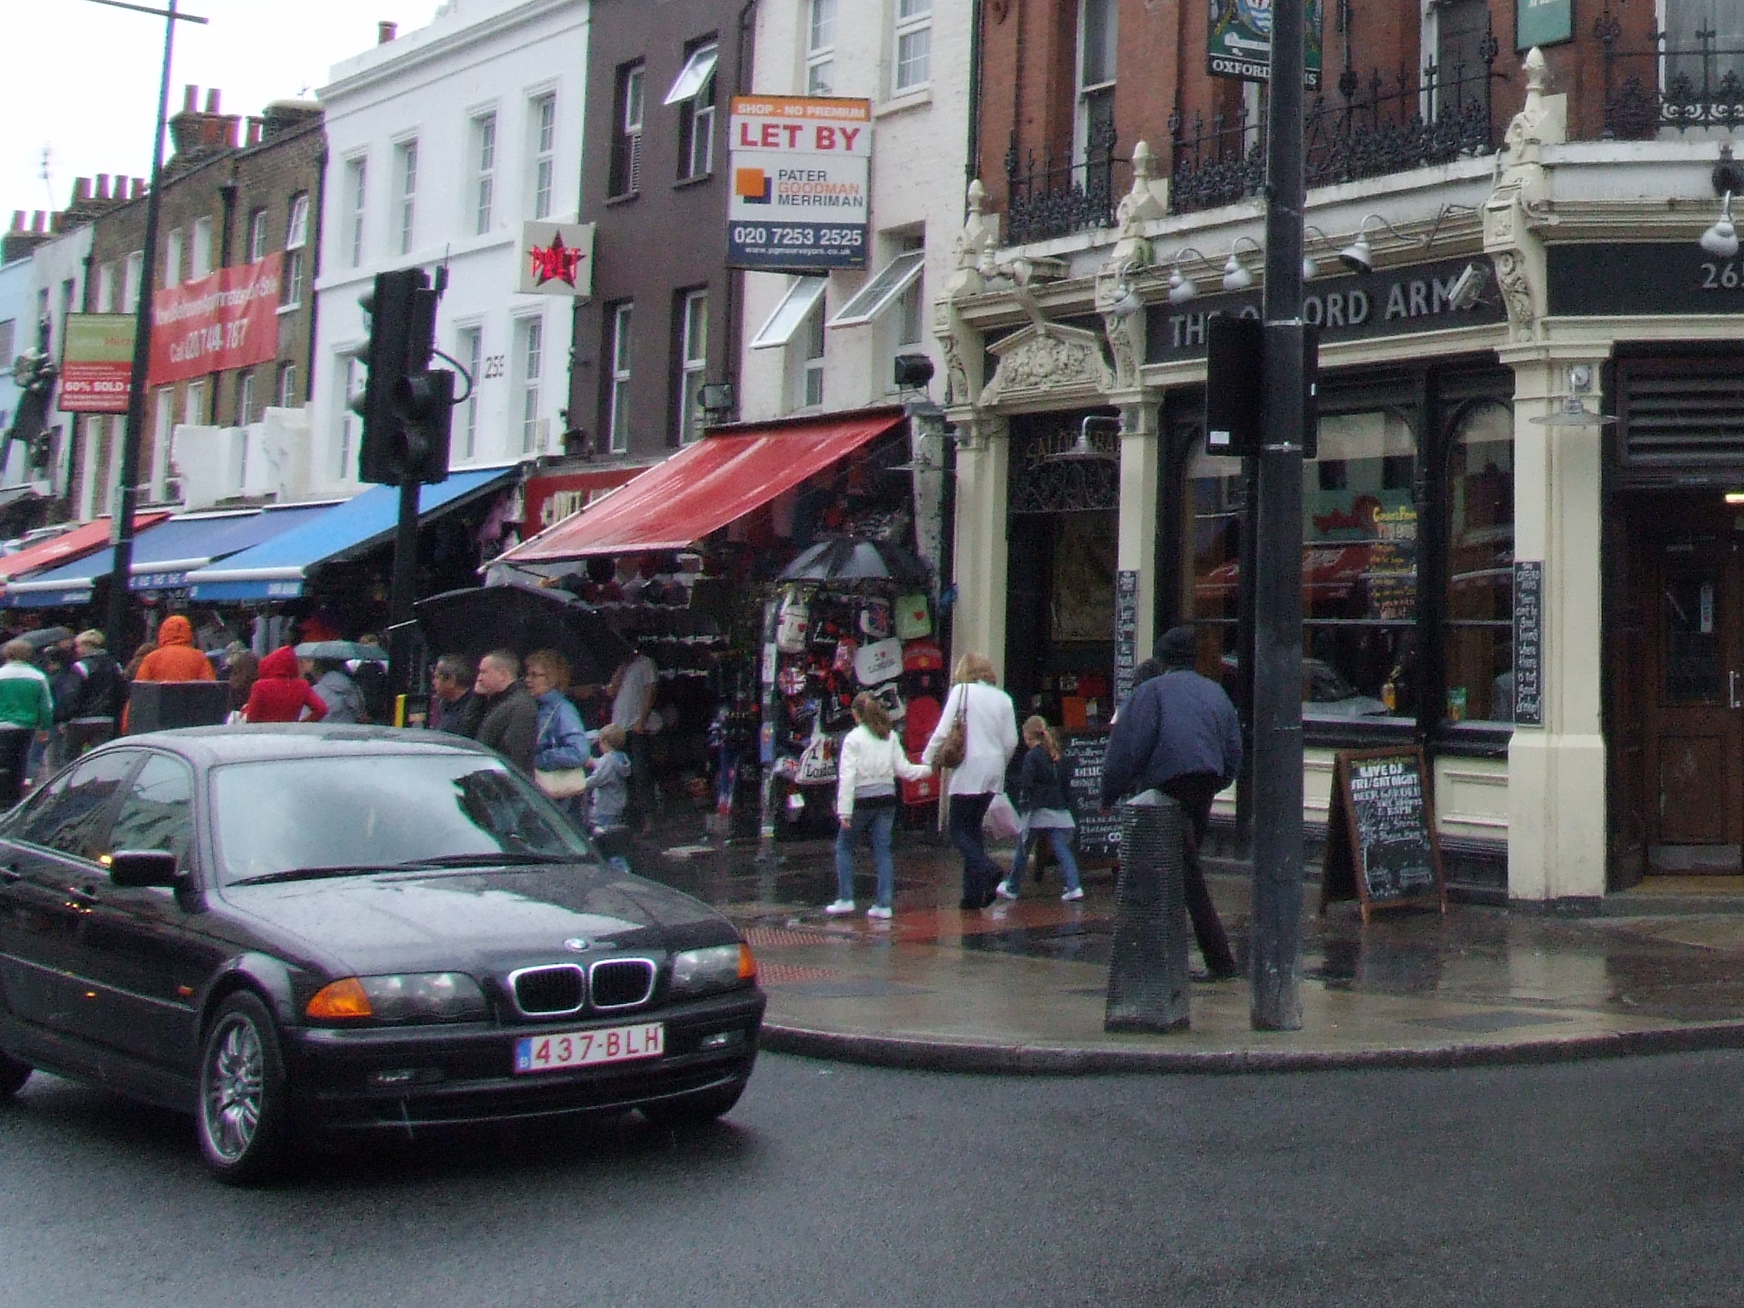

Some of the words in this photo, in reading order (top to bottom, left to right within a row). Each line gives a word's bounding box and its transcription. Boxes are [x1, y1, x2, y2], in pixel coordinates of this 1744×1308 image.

[1212, 59, 1271, 78] OXFORD
[738, 103, 773, 113] SHOP
[785, 105, 803, 115] NO
[807, 107, 865, 118] PREMIUM
[740, 122, 803, 148] LET
[815, 125, 860, 151] BY
[778, 169, 828, 182] PATER
[778, 182, 860, 195] GOODMAN
[778, 194, 863, 207] MERRIMAN
[734, 227, 766, 243] 020
[772, 228, 814, 244] 7253
[820, 229, 862, 245] 2525
[1169, 309, 1222, 348] TH
[1384, 275, 1462, 320] ARM
[93, 381, 125, 392] SOLD
[1360, 765, 1388, 777] LIVE
[1390, 763, 1403, 775] DJ
[535, 1027, 660, 1064] 437-BLH
